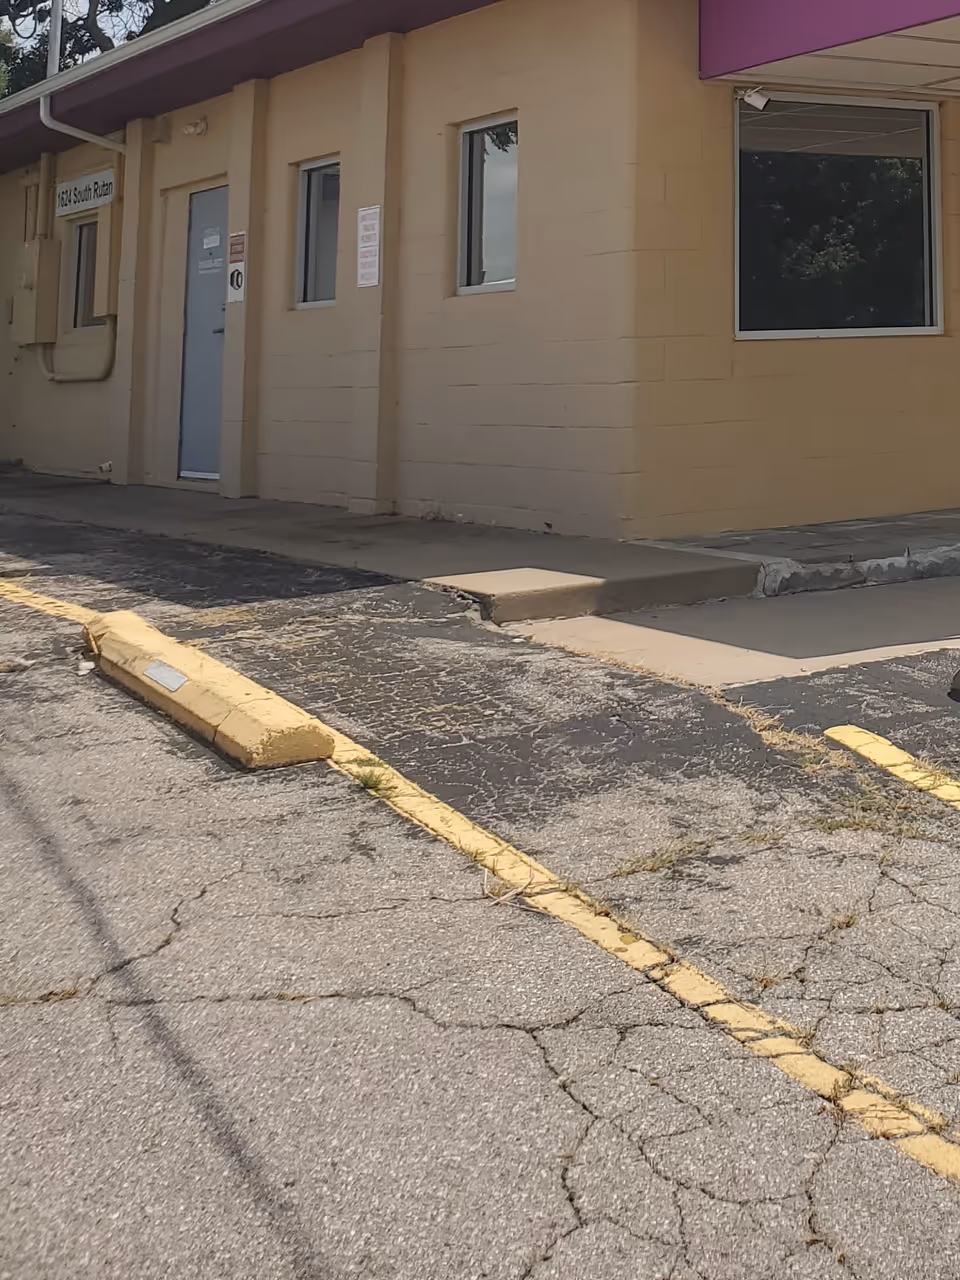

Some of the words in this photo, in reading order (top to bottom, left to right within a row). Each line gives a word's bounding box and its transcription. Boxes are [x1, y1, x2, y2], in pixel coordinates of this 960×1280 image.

[57, 188, 72, 208] 1624
[73, 183, 92, 204] South
[93, 181, 113, 199] Rutan
